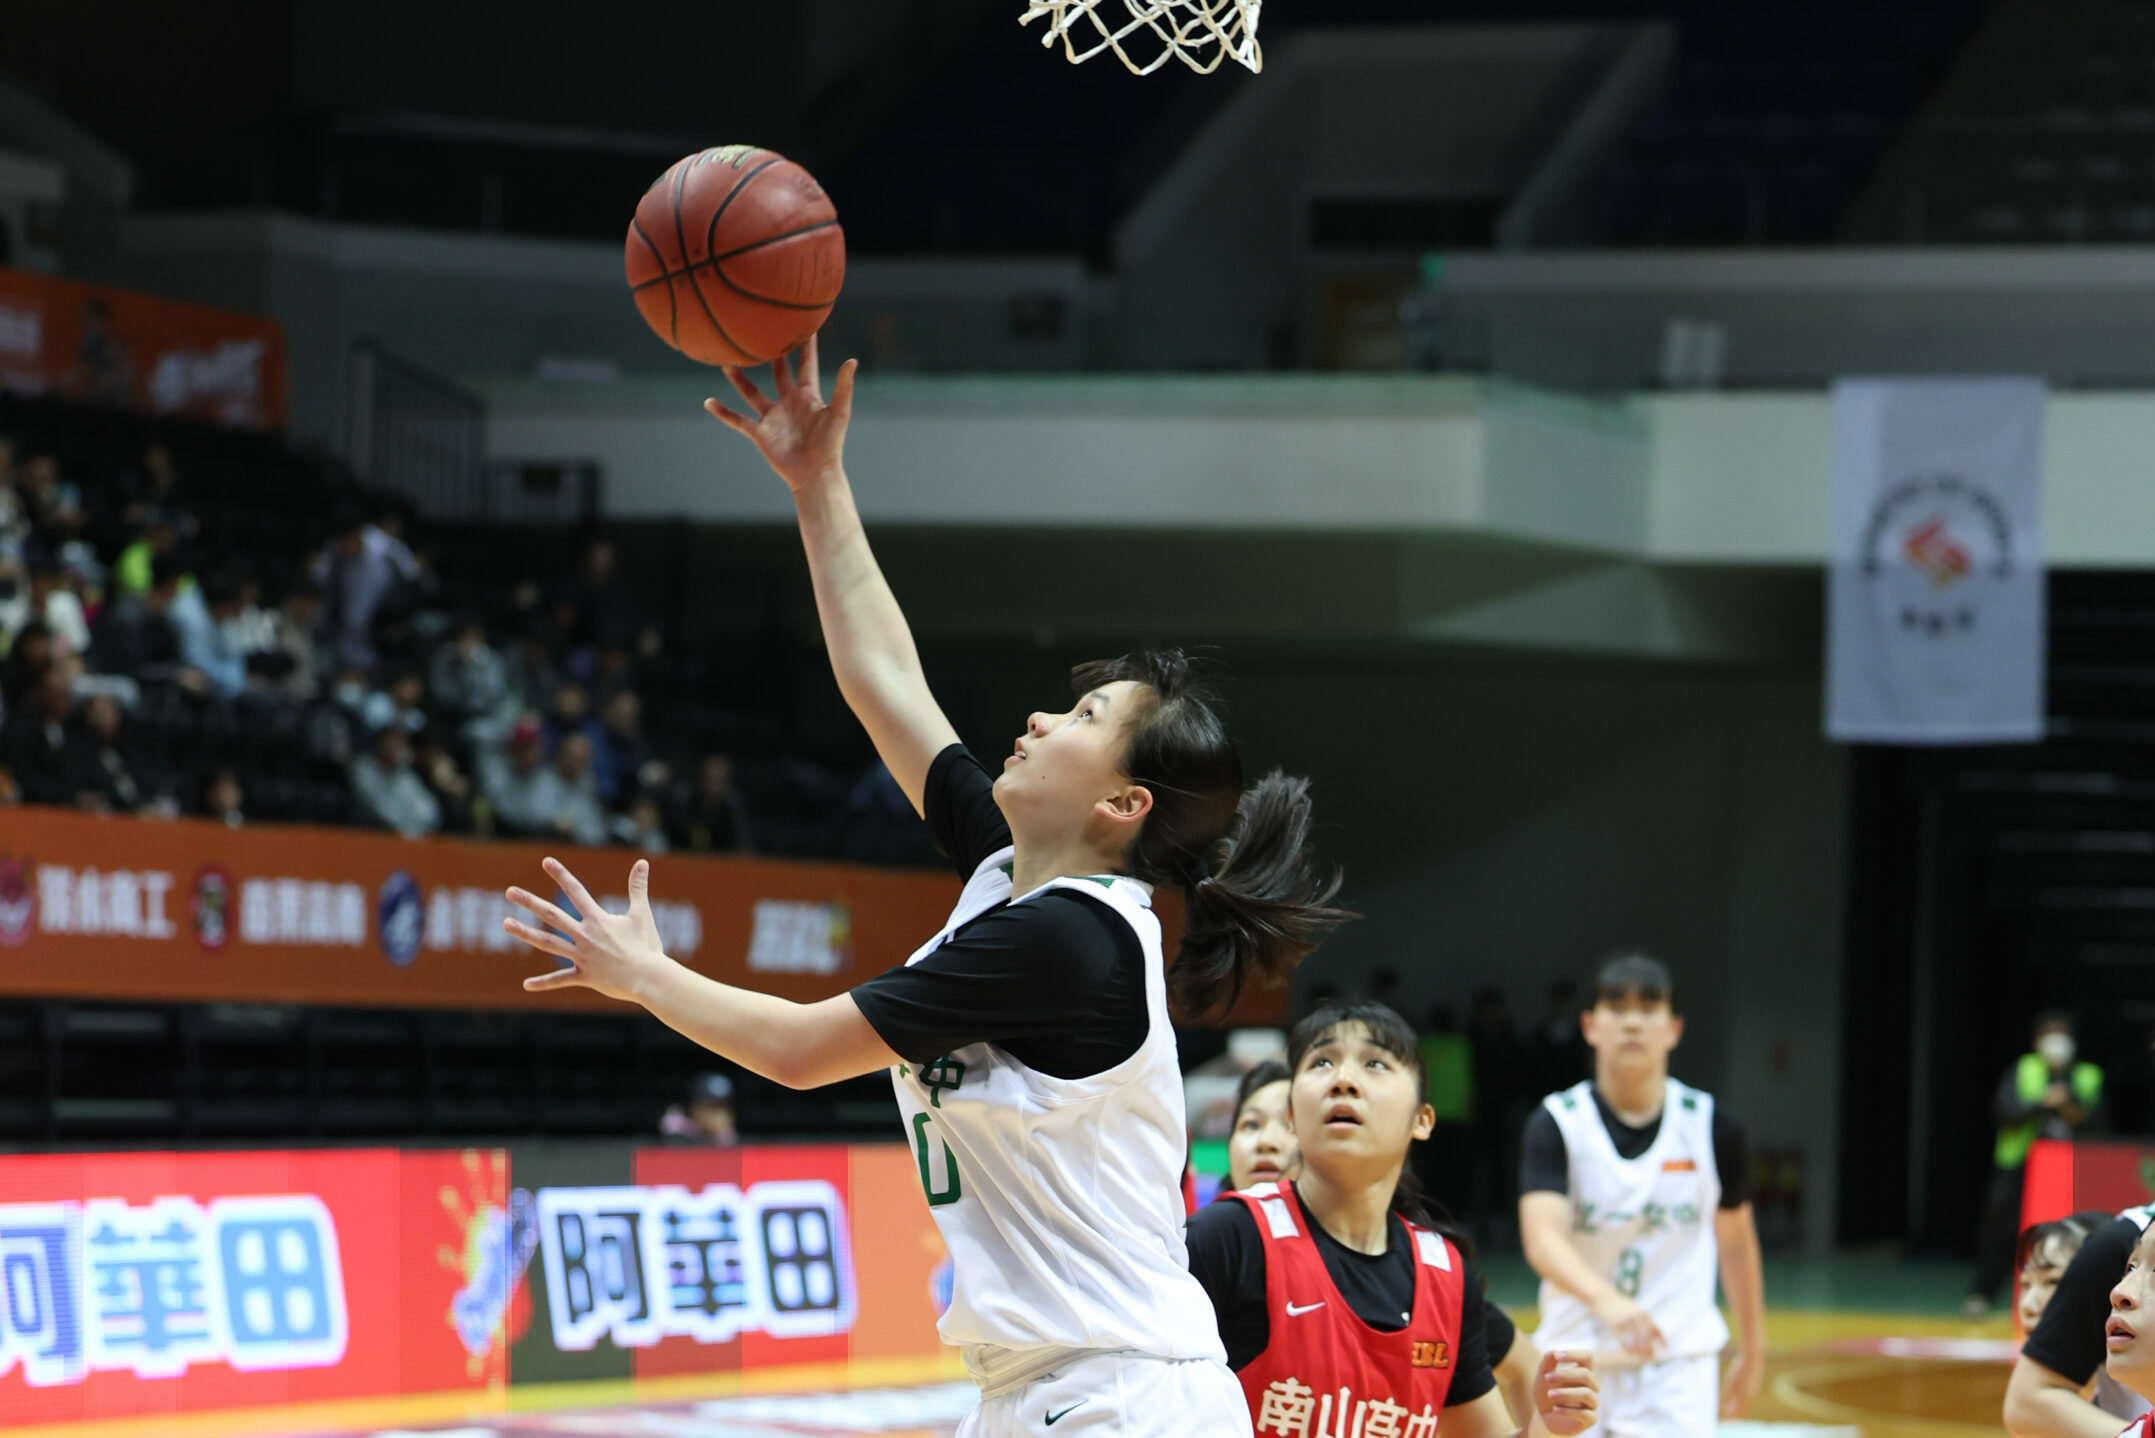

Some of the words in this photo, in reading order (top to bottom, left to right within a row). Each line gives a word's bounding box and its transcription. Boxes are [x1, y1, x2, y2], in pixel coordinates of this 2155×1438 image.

[537, 1180, 857, 1351] 阿華田
[1616, 1247, 1643, 1298] 8
